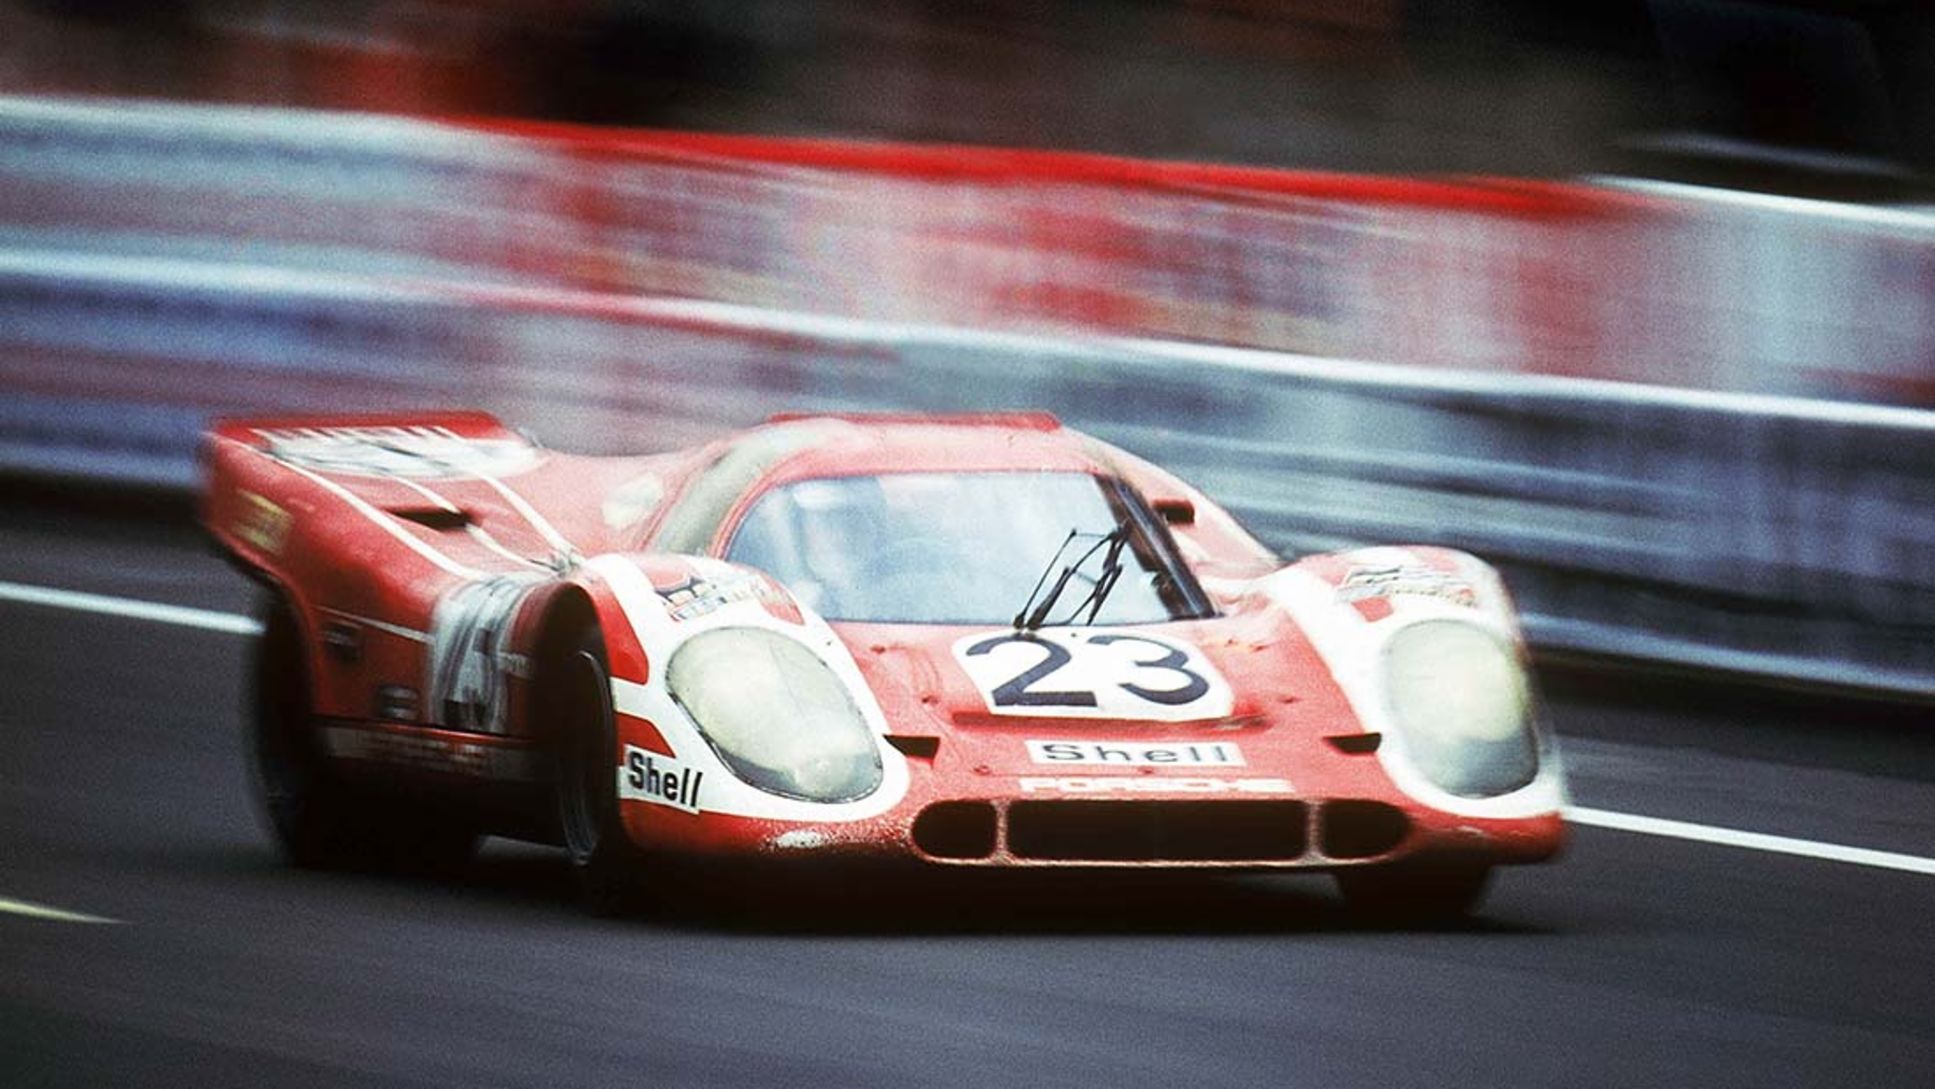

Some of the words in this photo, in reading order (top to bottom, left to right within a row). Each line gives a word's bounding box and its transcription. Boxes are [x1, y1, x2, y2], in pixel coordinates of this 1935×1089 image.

[966, 634, 1210, 707] 23
[628, 750, 703, 807] Shell
[1042, 744, 1231, 764] Shell
